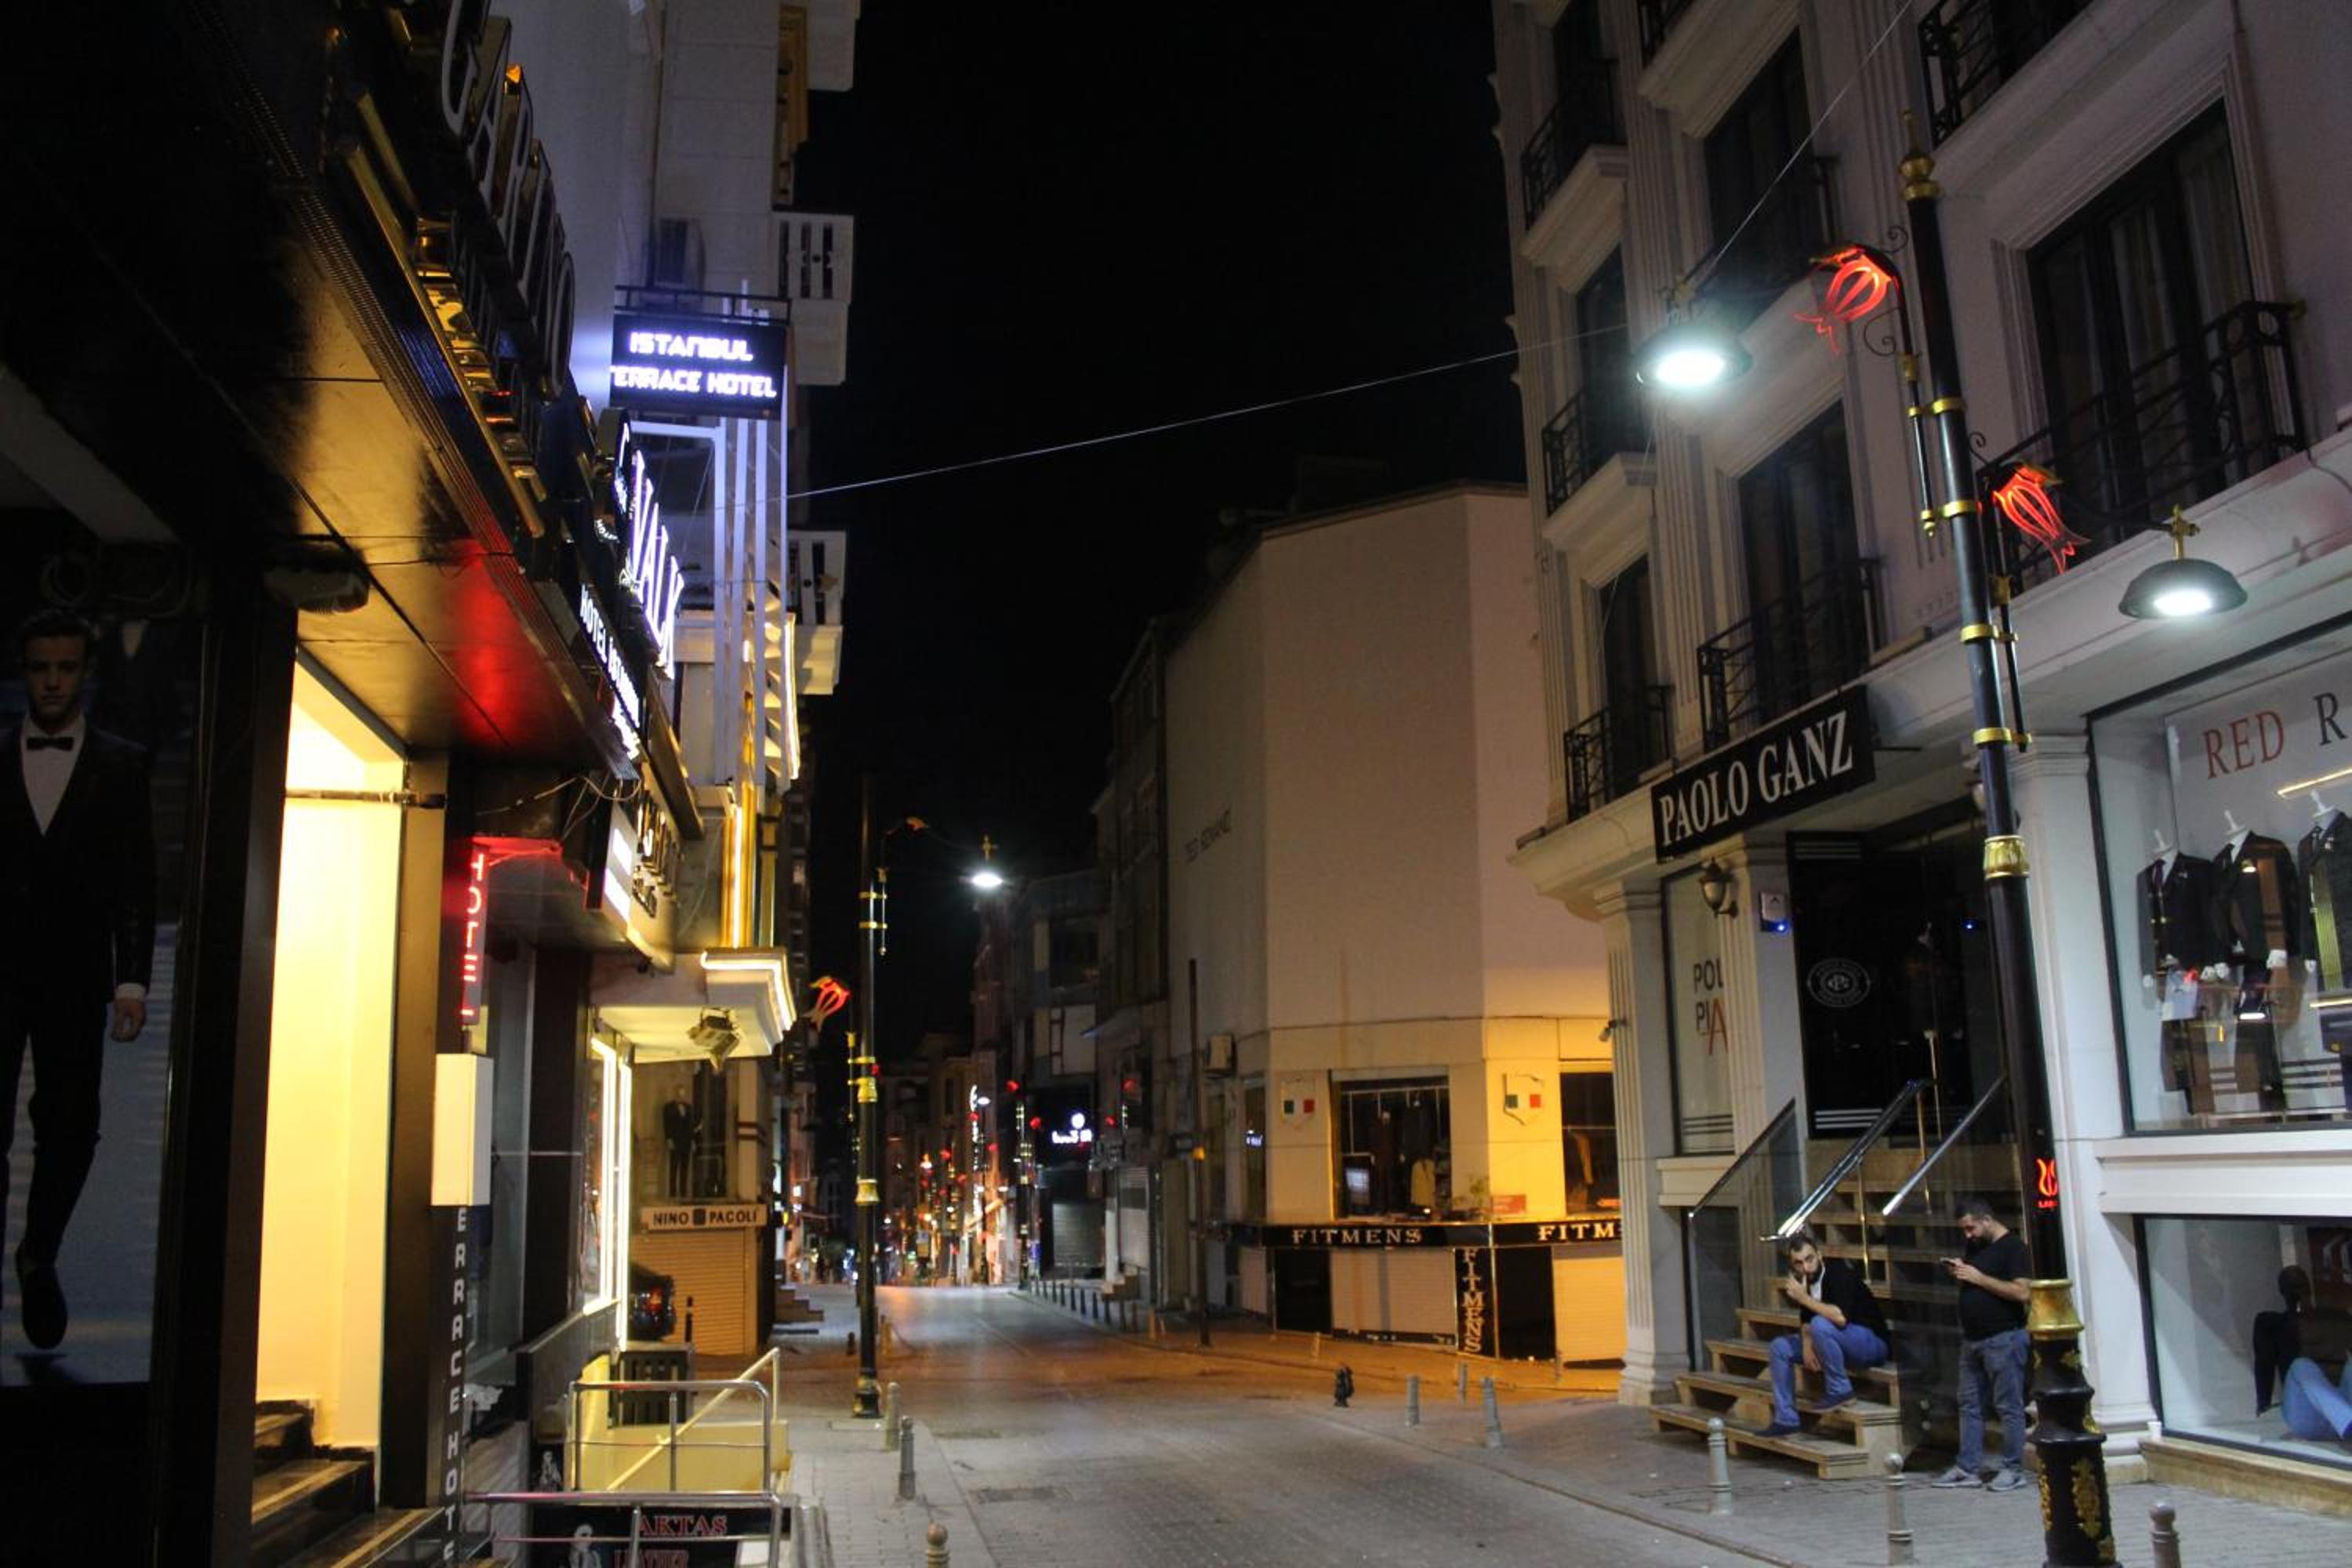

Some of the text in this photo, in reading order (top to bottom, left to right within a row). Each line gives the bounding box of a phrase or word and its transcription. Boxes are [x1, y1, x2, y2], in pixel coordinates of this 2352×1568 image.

[707, 372, 777, 397] HOTEL
[2204, 711, 2285, 779] RED
[1659, 710, 1853, 847] PAOLO GANZ
[653, 1210, 689, 1225] NINO
[1292, 1222, 1623, 1245] FITMENS FITM
[1461, 1247, 1483, 1353] FITMENS
